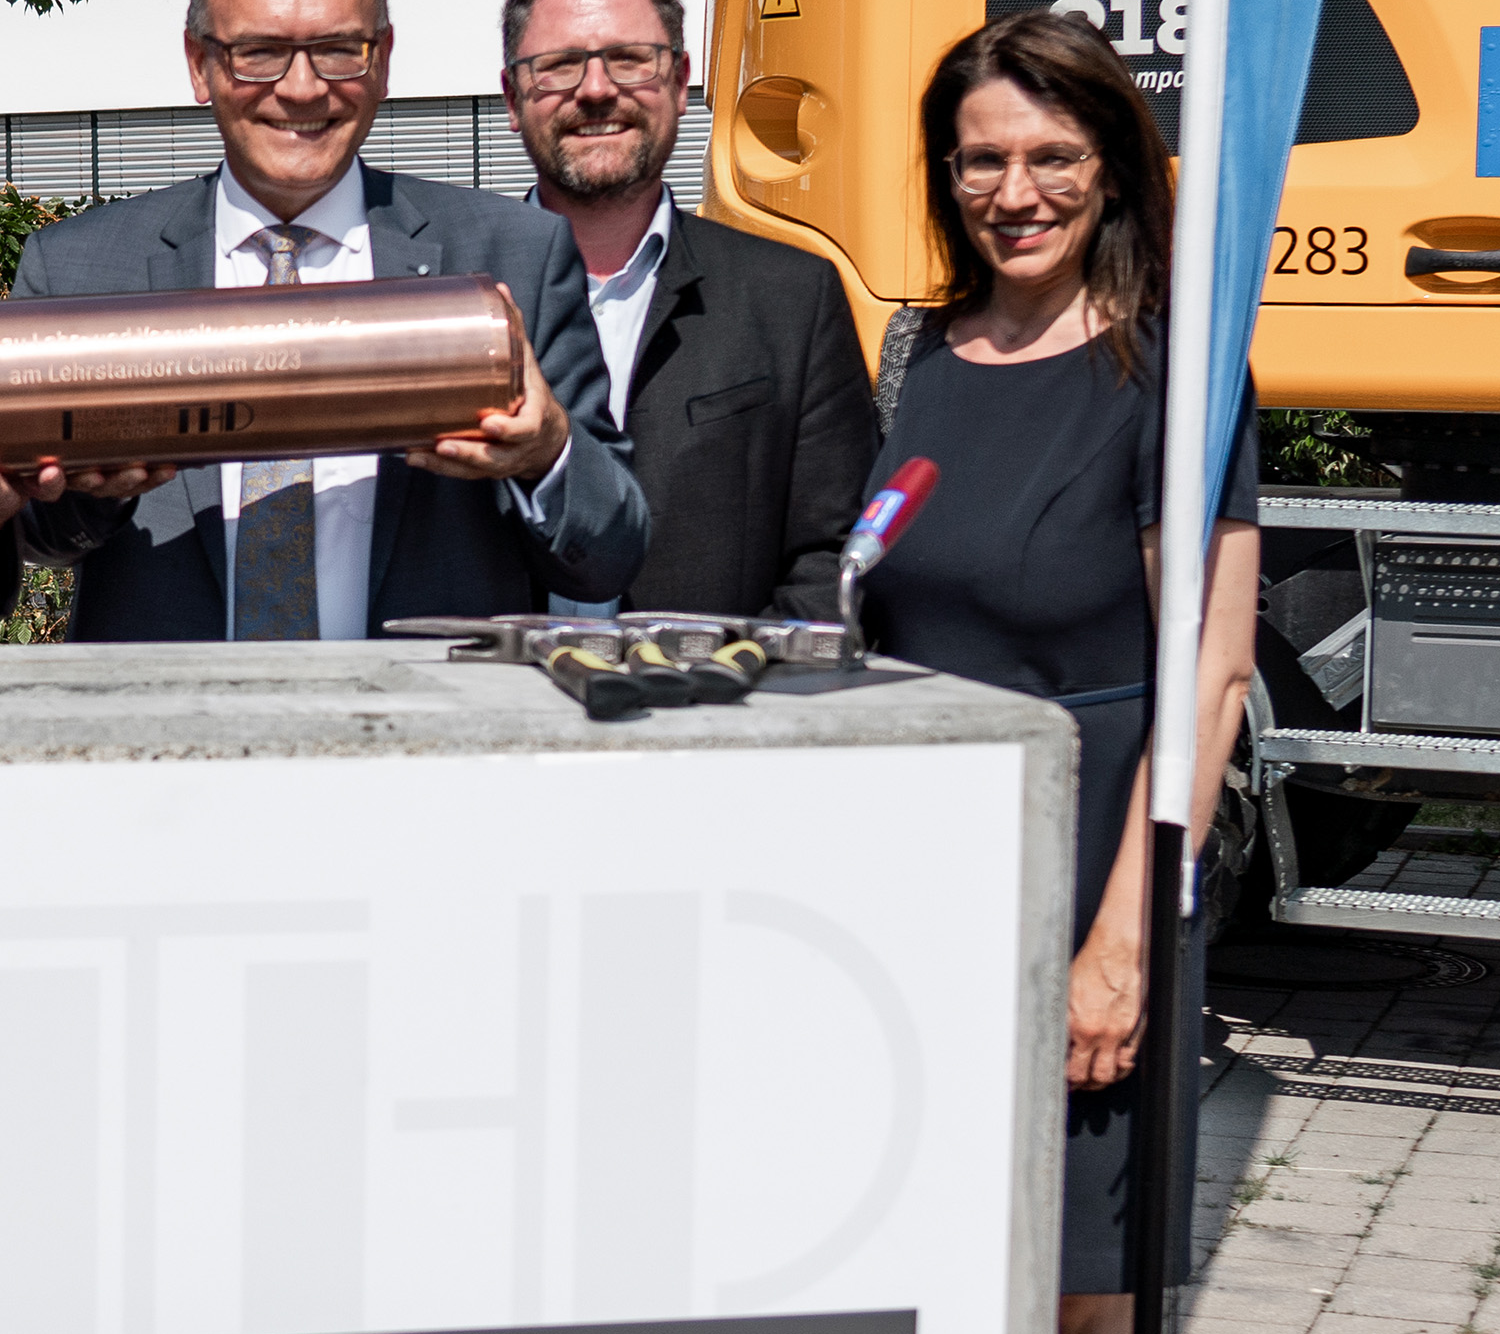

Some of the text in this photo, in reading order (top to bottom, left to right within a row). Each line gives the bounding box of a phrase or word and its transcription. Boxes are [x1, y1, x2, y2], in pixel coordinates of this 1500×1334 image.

[9, 348, 301, 385] am Lehrstandort Cham 2023
